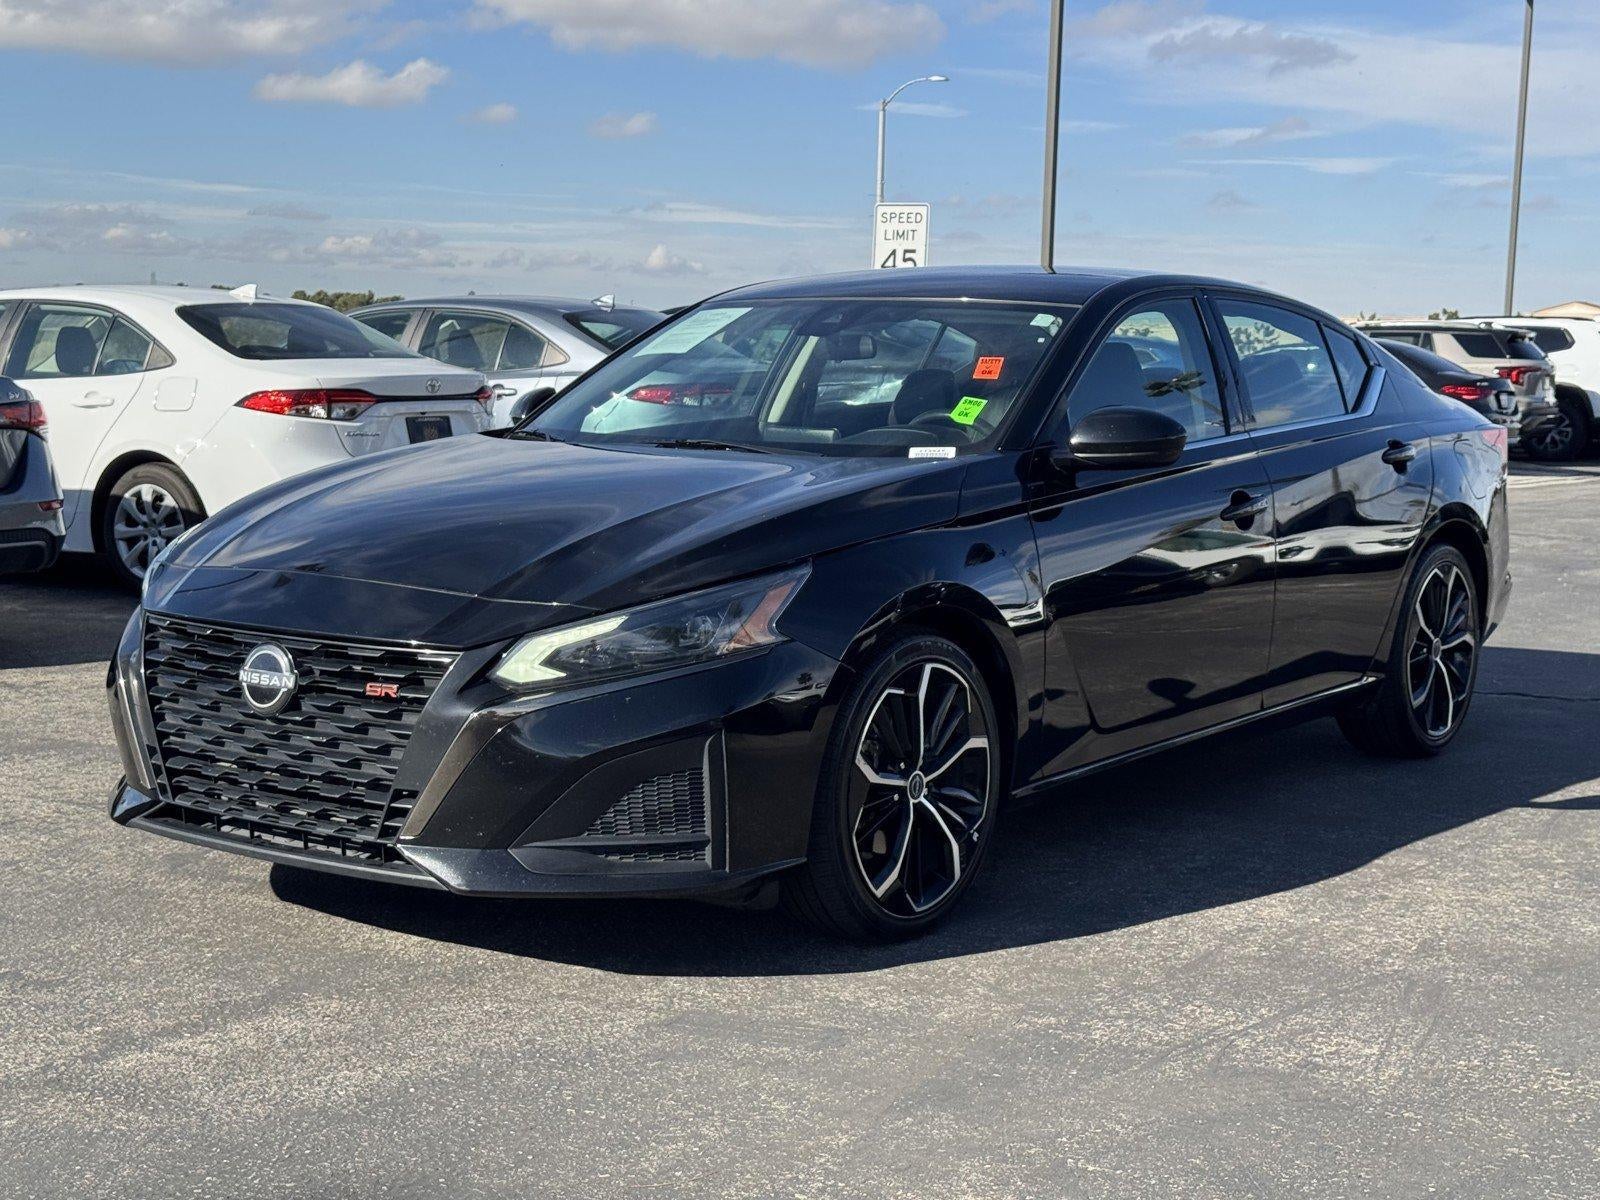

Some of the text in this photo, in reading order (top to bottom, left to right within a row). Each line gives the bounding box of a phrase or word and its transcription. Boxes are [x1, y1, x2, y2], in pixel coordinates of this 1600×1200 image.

[881, 212, 923, 223] SPEED
[884, 229, 917, 241] LIMIT
[881, 248, 917, 268] 45
[962, 399, 983, 407] SMOG
[958, 410, 971, 418] OK
[239, 669, 295, 688] NISSAN
[365, 682, 399, 698] SR
